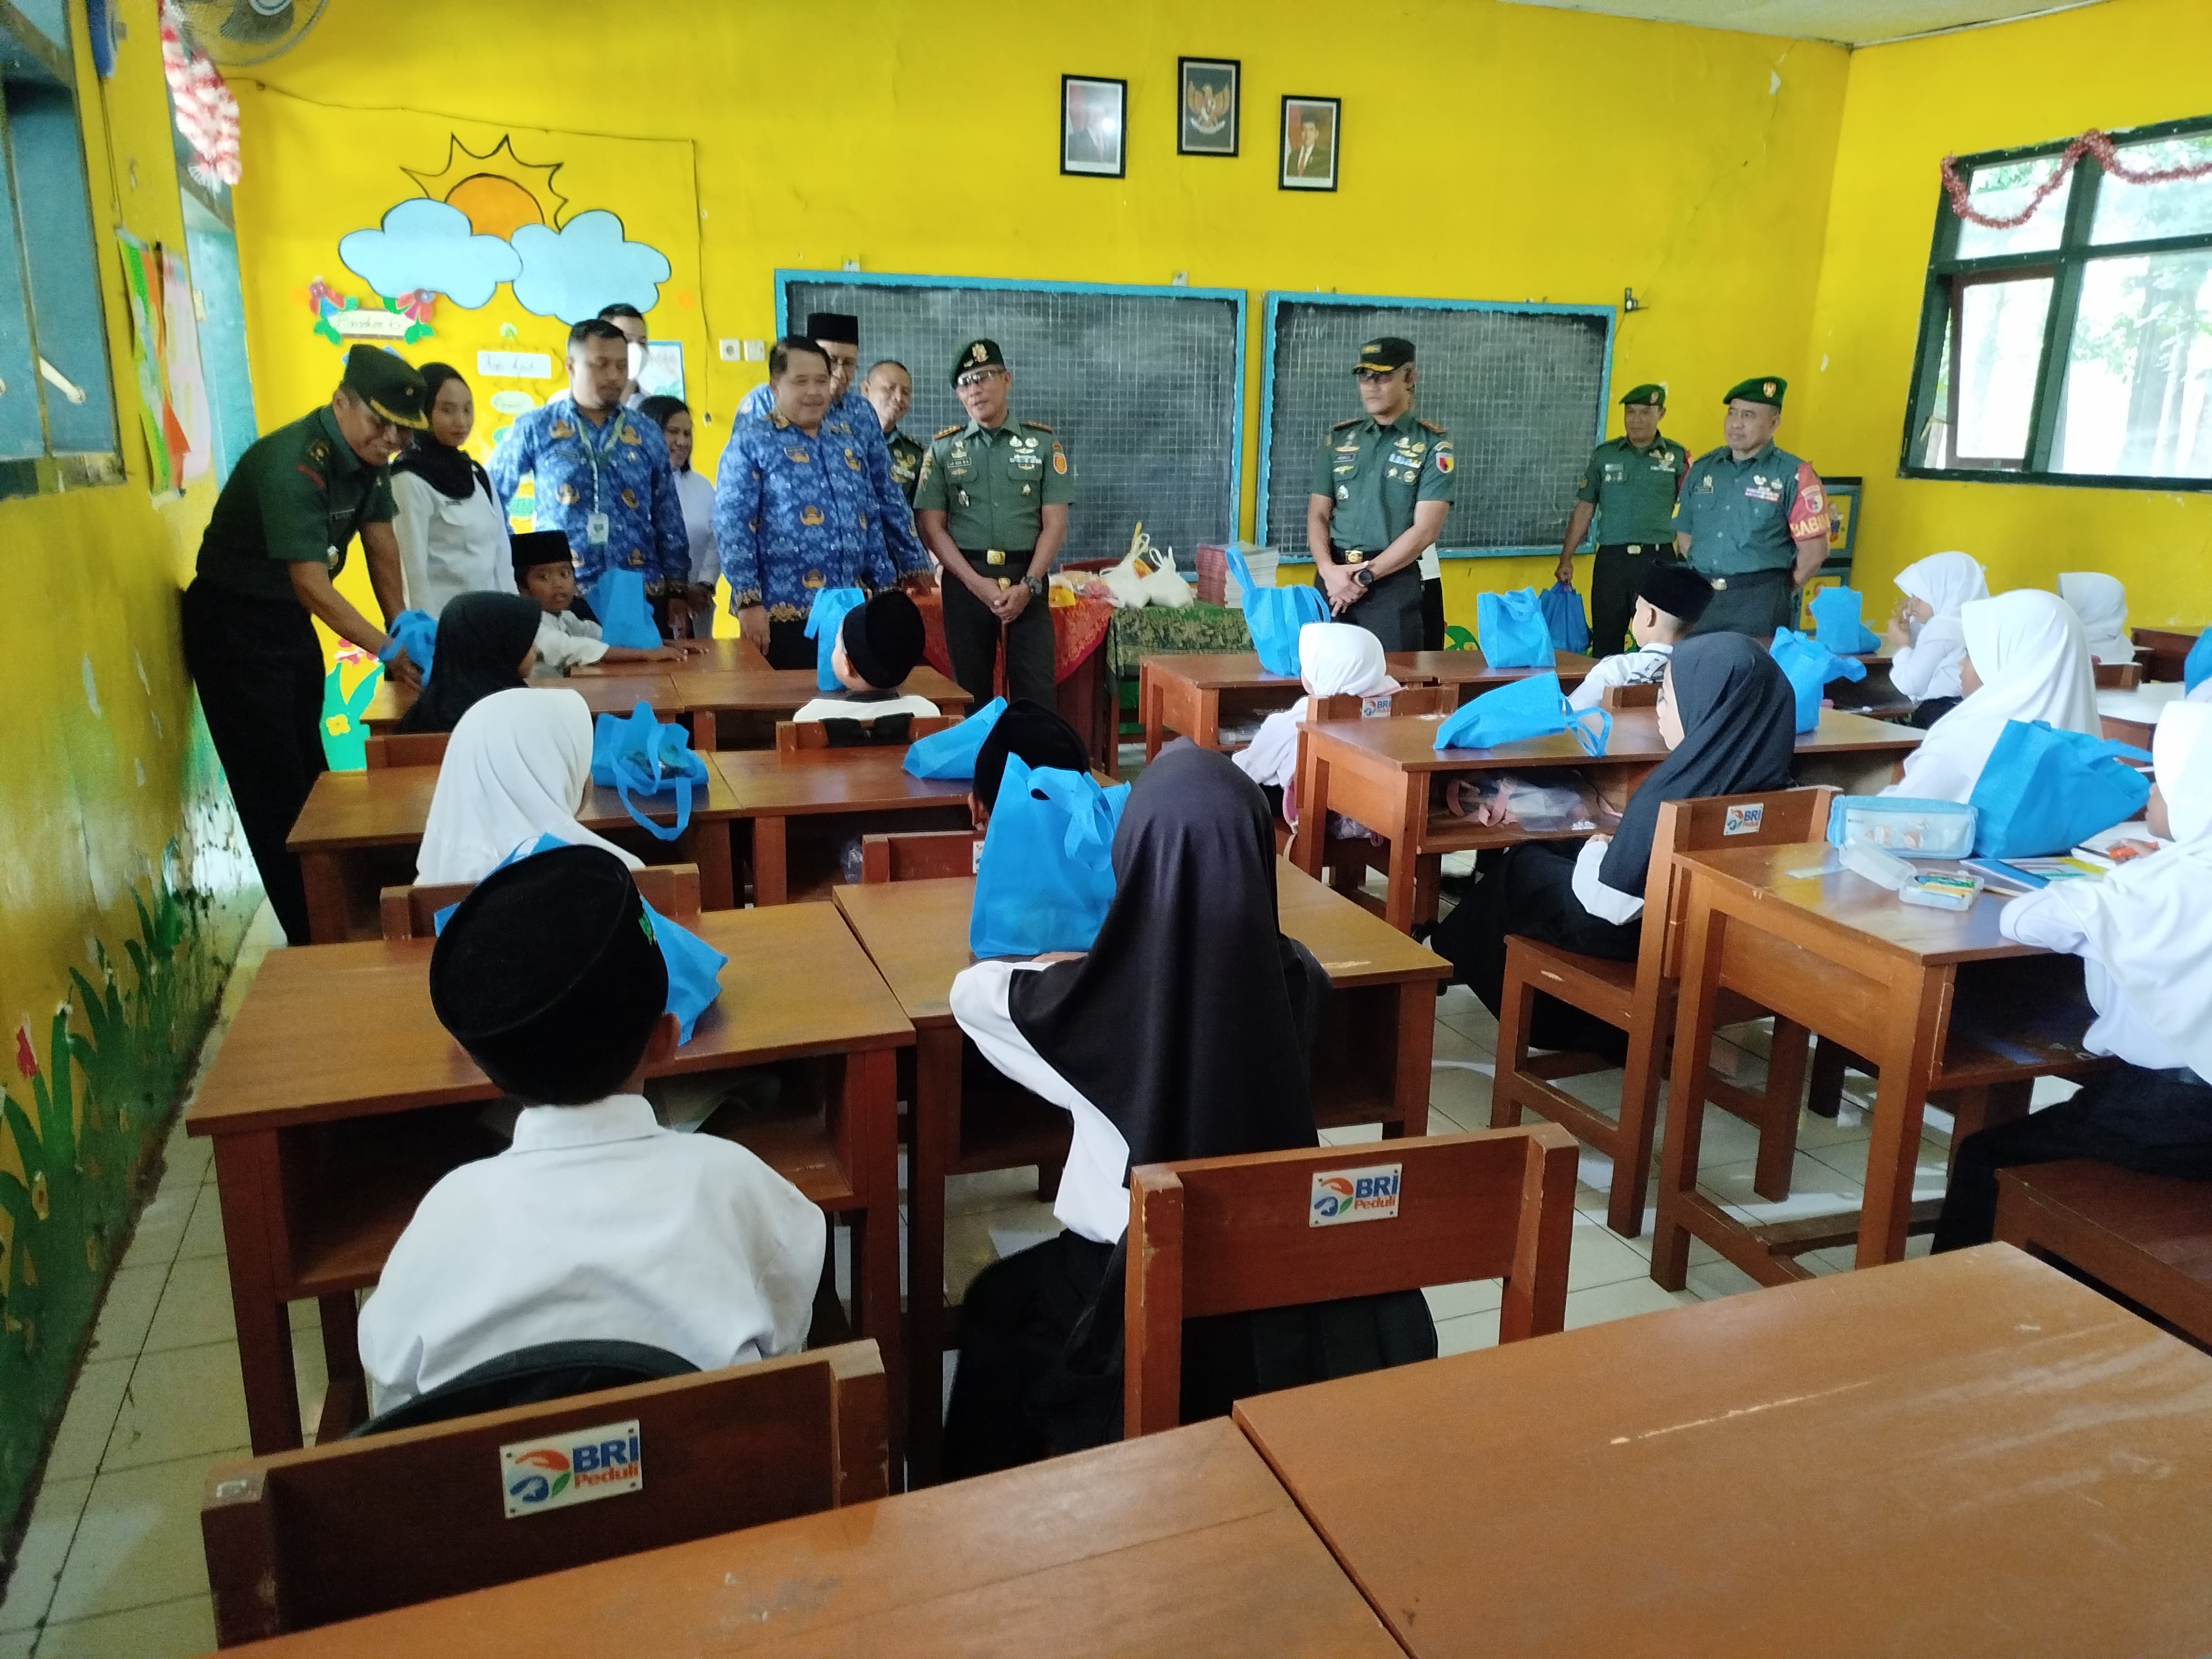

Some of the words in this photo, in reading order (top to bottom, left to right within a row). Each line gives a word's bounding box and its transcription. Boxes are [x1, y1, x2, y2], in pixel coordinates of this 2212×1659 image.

[1377, 700, 1391, 709] BRI
[1744, 810, 1761, 822] BRI
[1356, 1175, 1399, 1198] BRI
[1354, 1194, 1396, 1211] Peduli
[573, 1436, 639, 1474] BRI
[574, 1463, 639, 1489] Peduli
